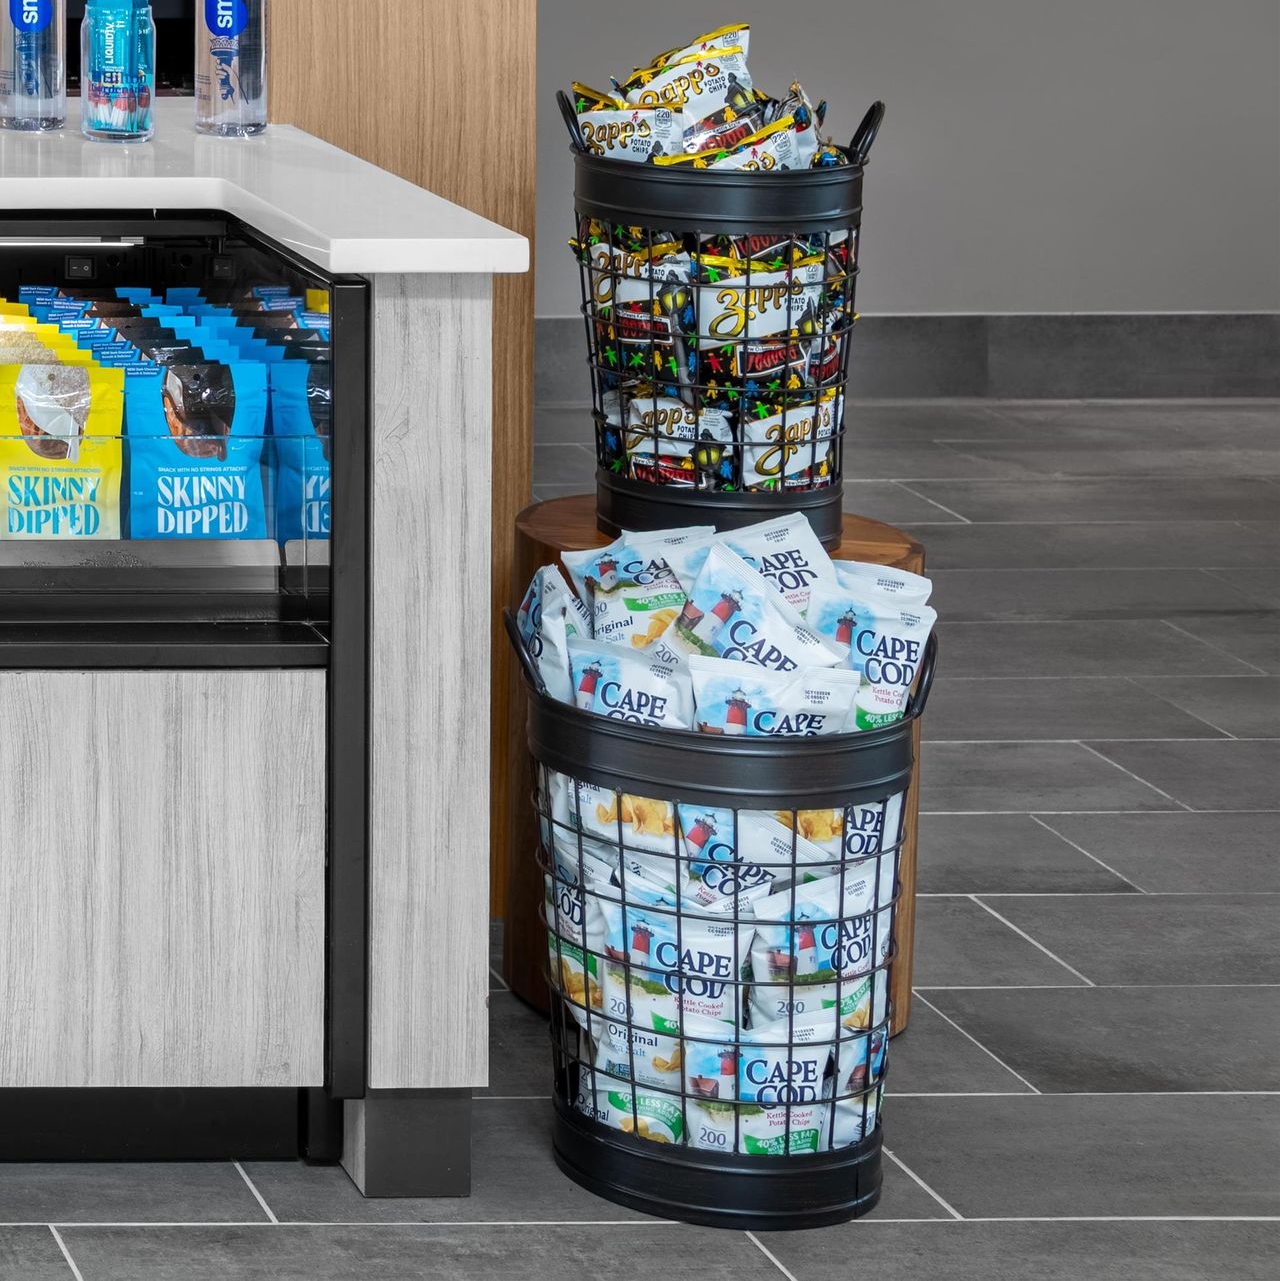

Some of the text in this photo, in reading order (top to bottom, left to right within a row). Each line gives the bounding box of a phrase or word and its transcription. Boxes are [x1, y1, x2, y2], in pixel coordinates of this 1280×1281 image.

[630, 139, 652, 147] POTATO
[632, 146, 649, 155] CHIPS
[8, 475, 100, 507] SKINNY
[157, 475, 246, 507] SKINNY
[8, 505, 100, 536] DIPPED
[158, 502, 248, 534] DIPPED
[855, 629, 920, 664] CAPE
[864, 661, 914, 687] COD
[600, 681, 667, 720] CAPE
[753, 710, 826, 735] CAPE
[745, 1059, 819, 1085] CAPE
[756, 1084, 817, 1110] COD
[698, 1127, 727, 1146] 200
